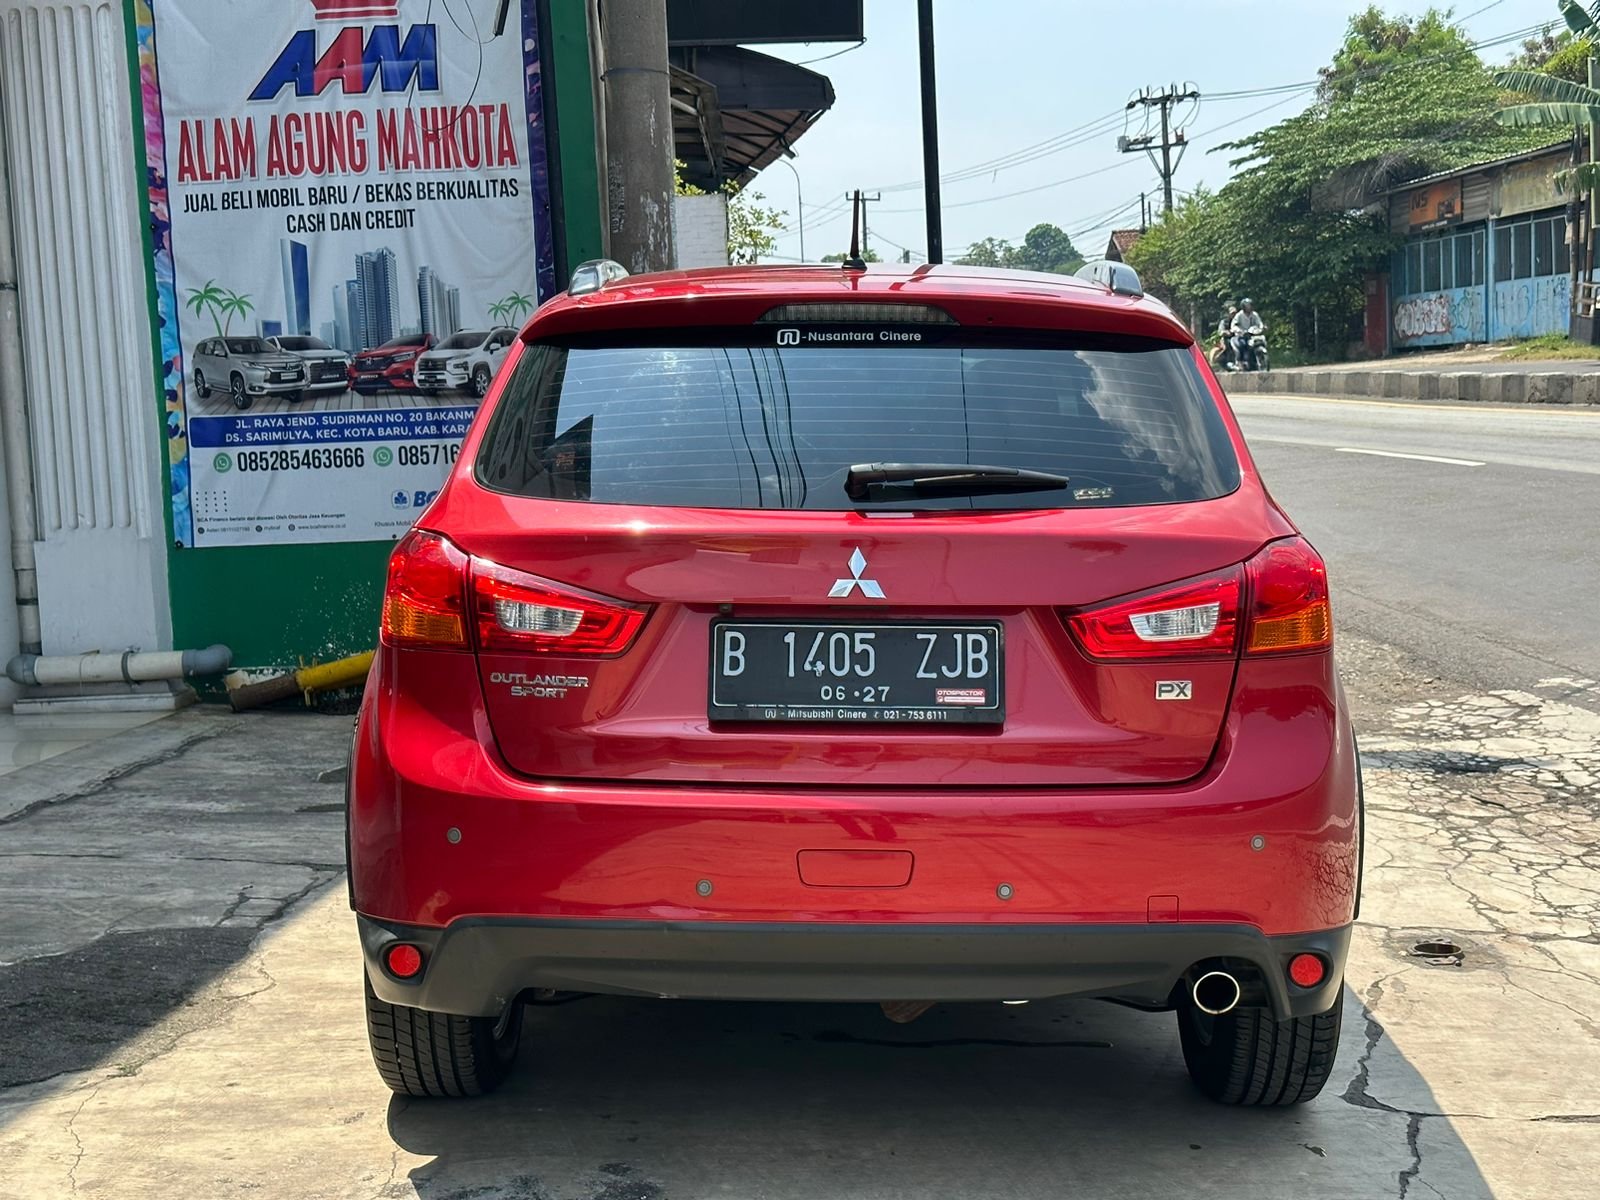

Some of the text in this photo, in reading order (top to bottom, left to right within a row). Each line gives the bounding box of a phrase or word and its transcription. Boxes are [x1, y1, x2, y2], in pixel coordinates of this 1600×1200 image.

[248, 23, 440, 100] AAM
[177, 103, 519, 183] ALAM AGUNG MAHKOTA
[184, 178, 519, 213] JUAL BELI MOBIL BARU / BEKAS BERKUALITAS
[286, 208, 416, 233] CASH DAN CREDIT
[879, 331, 922, 341] Cinere
[236, 419, 251, 429] JL.
[254, 417, 284, 429] RAYA
[287, 416, 319, 428] JEND.
[322, 413, 383, 426] SUDIRMAN
[386, 412, 406, 424] NO.
[409, 412, 423, 422] 20
[225, 433, 243, 443] DS.
[246, 429, 313, 442] SARIMULYA,
[316, 428, 342, 439] KEC.
[344, 426, 375, 438] KOTA
[378, 425, 412, 437] BARU,
[415, 424, 440, 435] KAB.
[237, 447, 364, 472] 085285463666
[722, 631, 989, 679] B 1405 ZJB
[490, 672, 589, 687] OUTLANDER
[511, 685, 568, 698] SPORT
[1157, 682, 1190, 698] PX
[788, 709, 834, 719] Mitsubishi
[837, 709, 867, 719] Cinere
